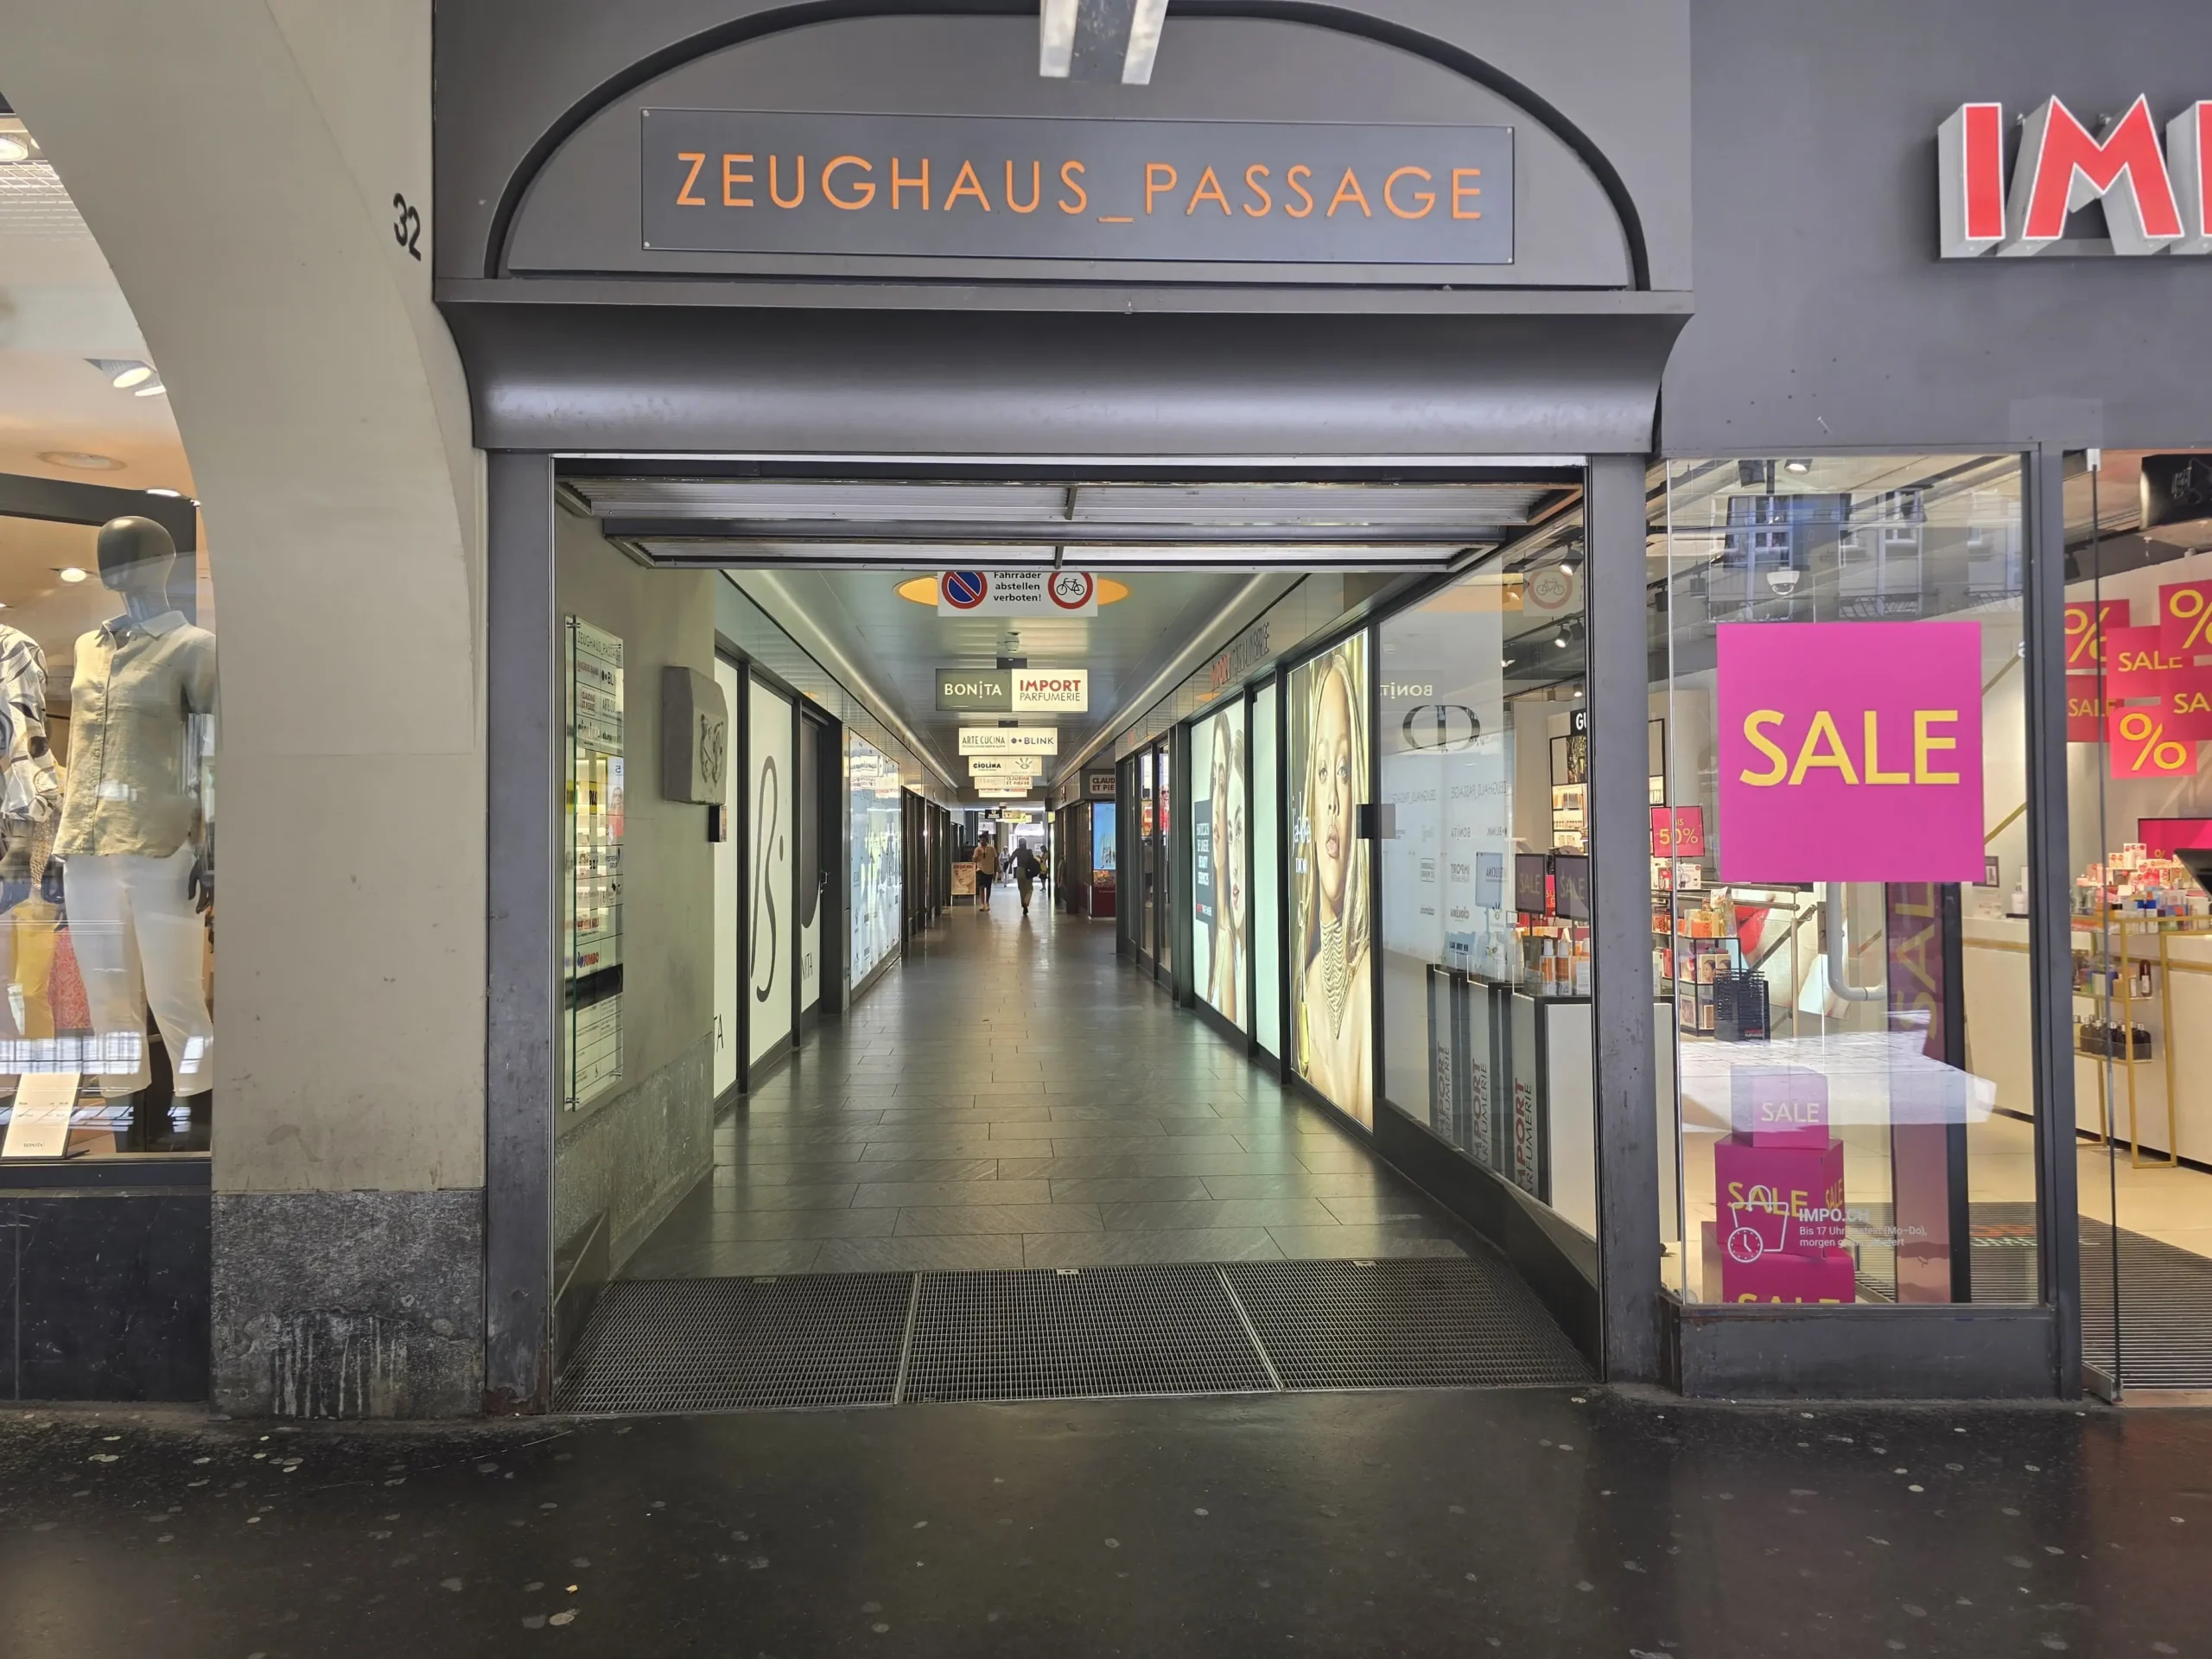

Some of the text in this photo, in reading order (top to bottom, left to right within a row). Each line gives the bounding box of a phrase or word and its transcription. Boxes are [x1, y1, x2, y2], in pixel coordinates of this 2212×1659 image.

[677, 151, 1484, 223] ZEUGHAUS_PASSAGE
[393, 193, 422, 262] 32
[995, 582, 1040, 590] abstellen
[993, 593, 1042, 601] verboten!
[1020, 679, 1081, 692] IMPORT
[1020, 692, 1081, 702] PARFUMERIE
[962, 735, 1006, 744] ARTE CUCINA
[1738, 709, 1960, 787] SALE
[1519, 874, 1541, 894] SALE
[1760, 1102, 1820, 1123] SALE
[1726, 1181, 1808, 1217] SALE
[1799, 1208, 1870, 1223] IMPO.CH
[1799, 1226, 1815, 1236] Bis
[1816, 1226, 1827, 1236] 17
[1829, 1226, 1846, 1236] Uhr
[1800, 1238, 1835, 1249] morgen
